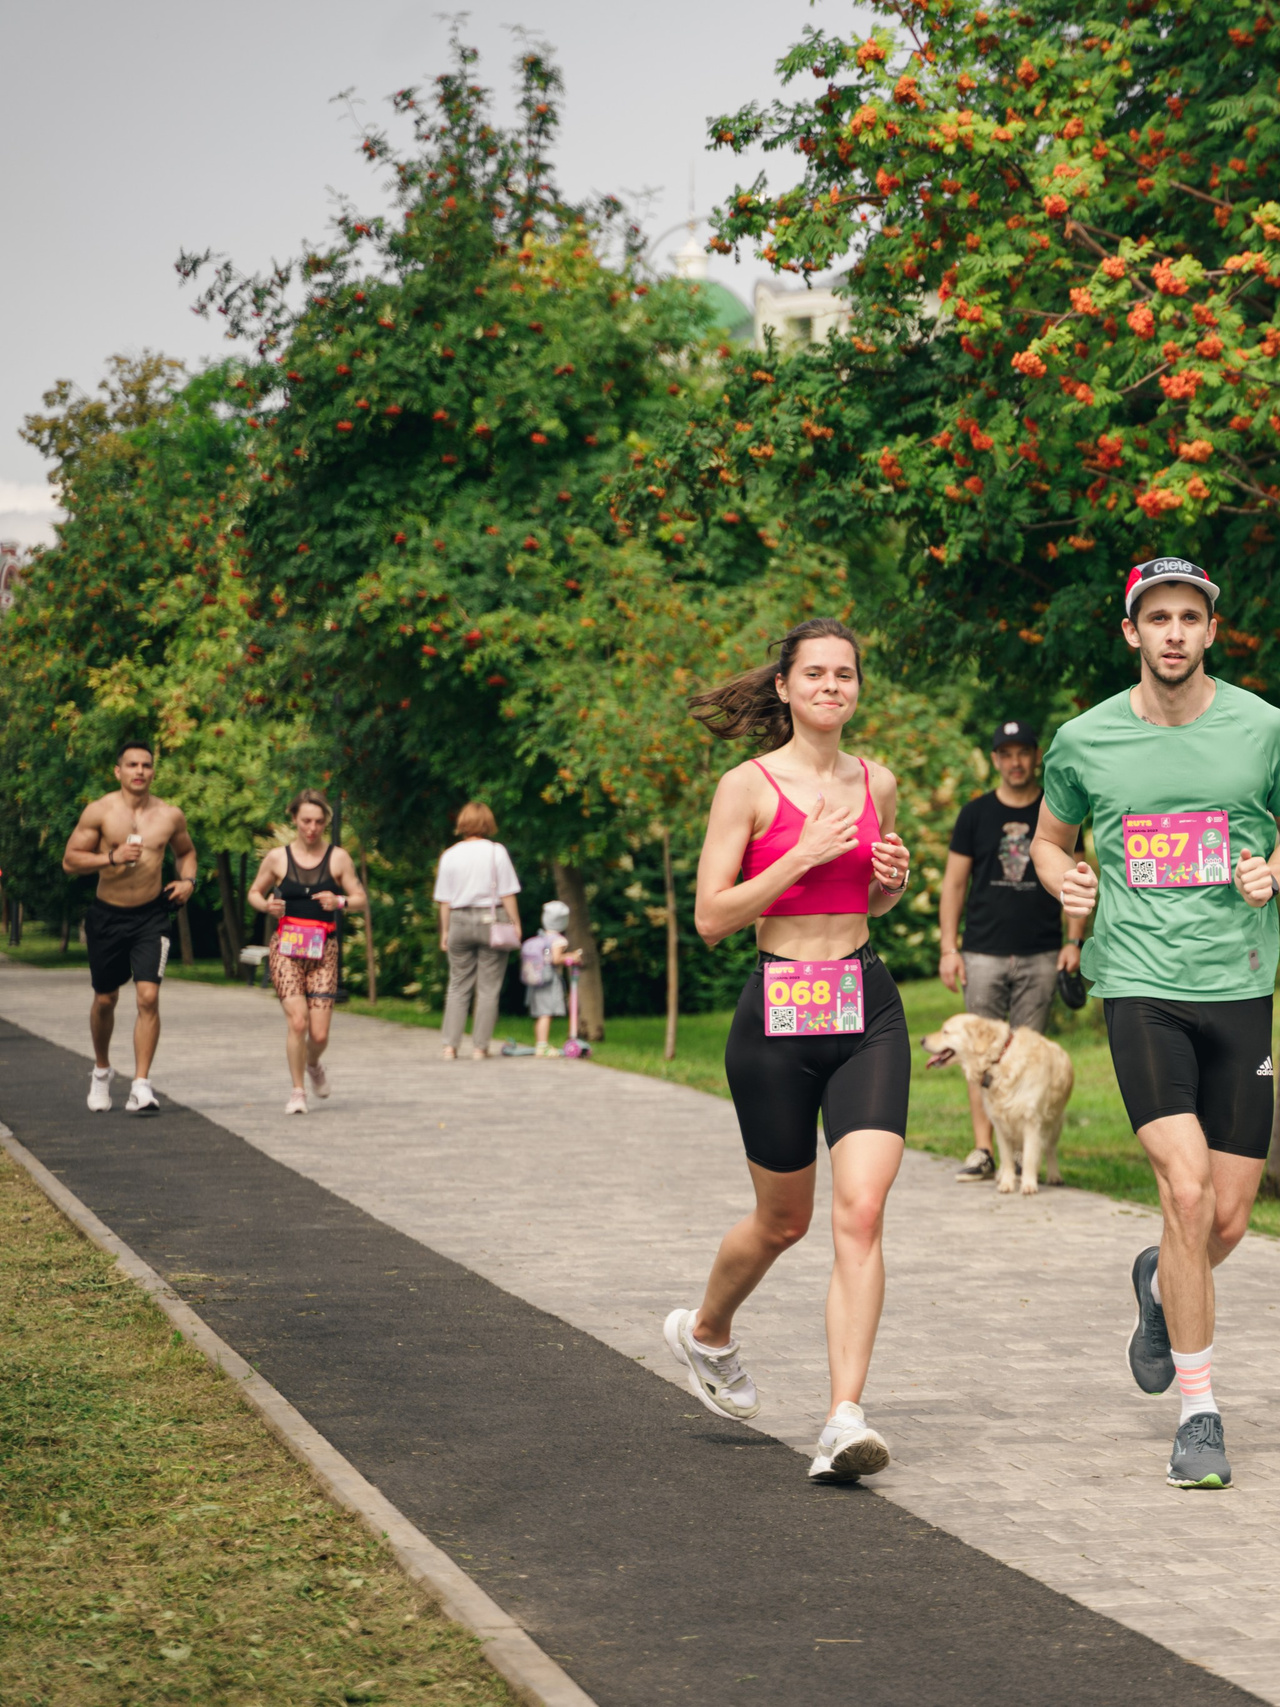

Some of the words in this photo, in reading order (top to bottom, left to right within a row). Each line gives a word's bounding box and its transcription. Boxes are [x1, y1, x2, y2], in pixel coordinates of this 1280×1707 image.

[1207, 832, 1217, 841] 2
[1127, 833, 1189, 858] 067
[281, 931, 304, 945] 261
[844, 976, 853, 986] 2
[768, 980, 831, 1005] 068
